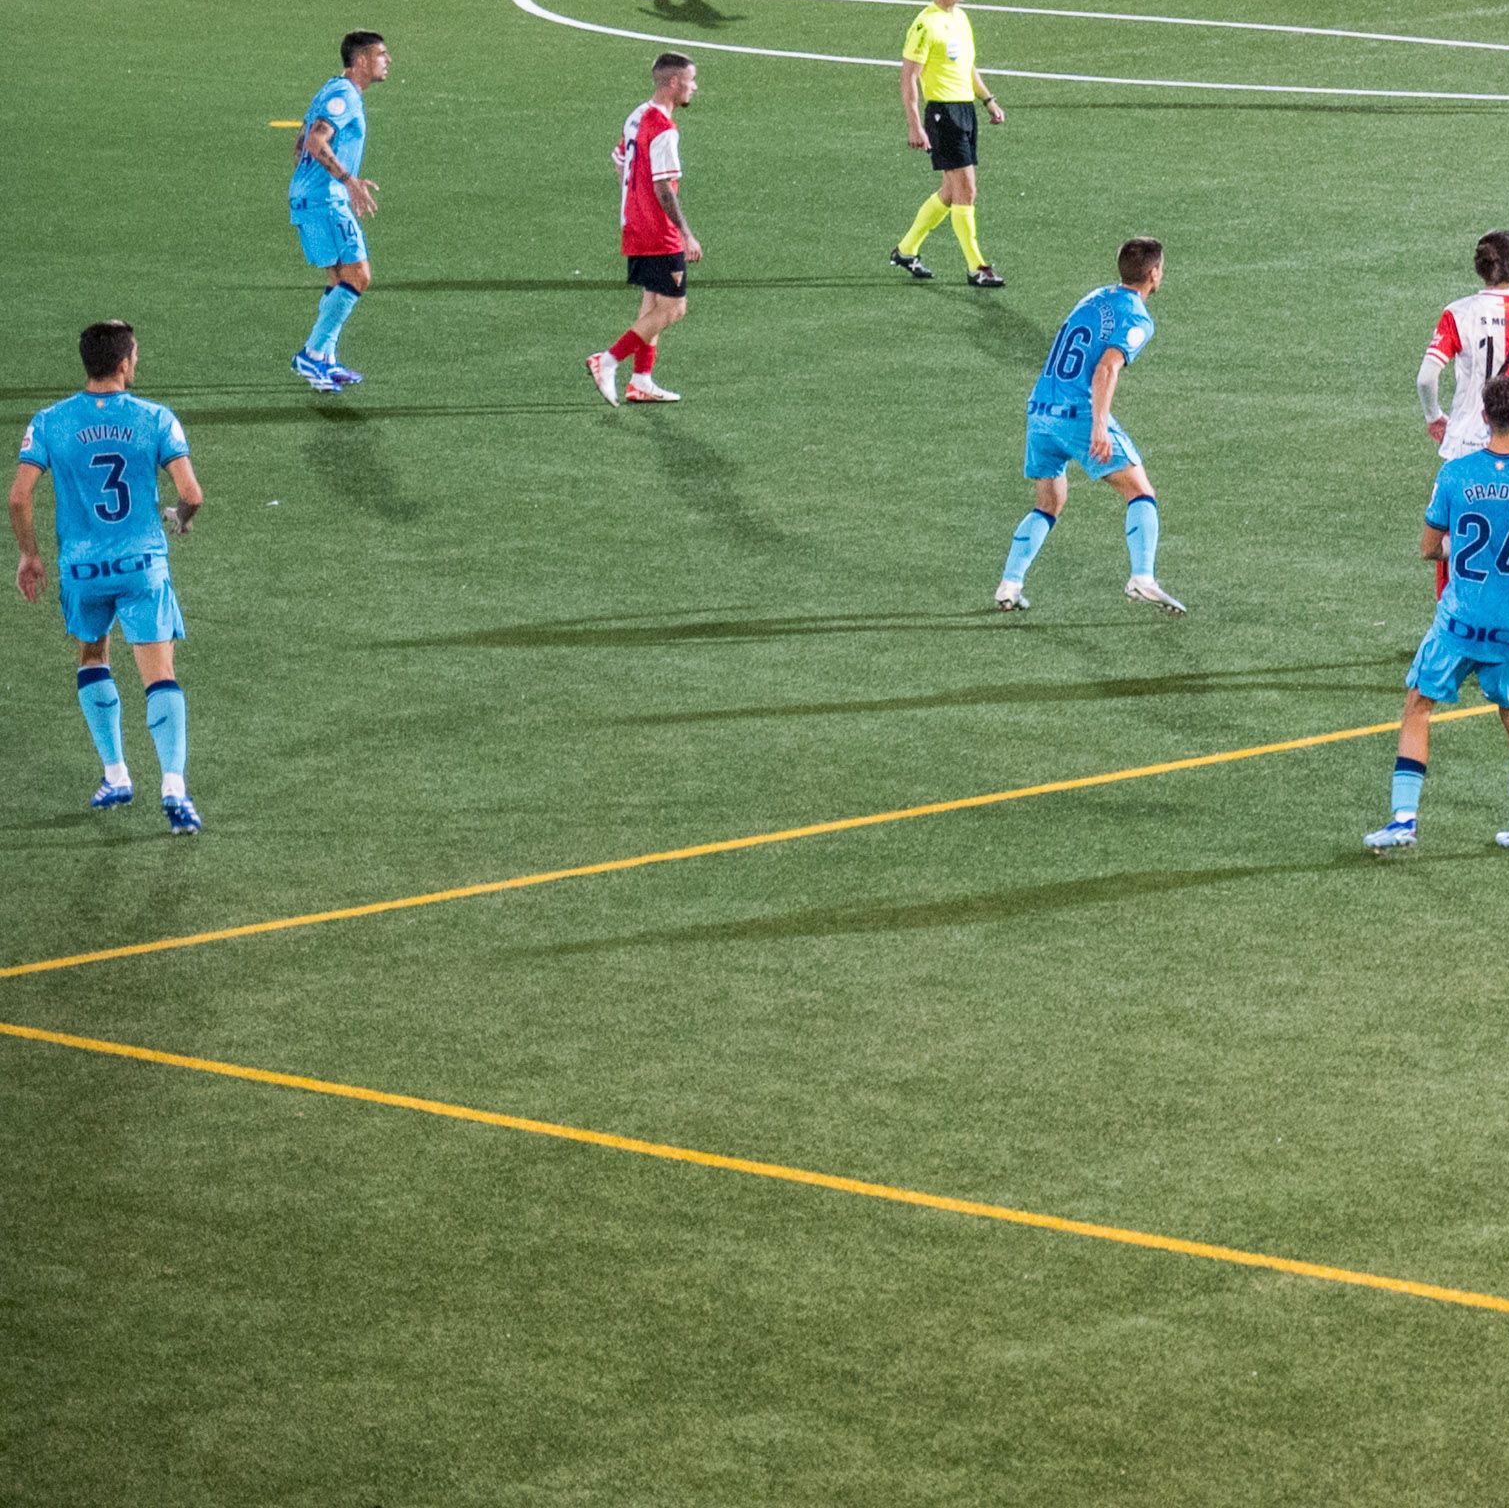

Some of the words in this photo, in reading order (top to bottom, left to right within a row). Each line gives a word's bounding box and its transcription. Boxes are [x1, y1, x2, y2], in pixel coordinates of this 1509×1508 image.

[1044, 322, 1094, 382] 16
[77, 425, 132, 443] VIVIAN
[90, 452, 131, 523] 3
[71, 554, 152, 580] DIGI
